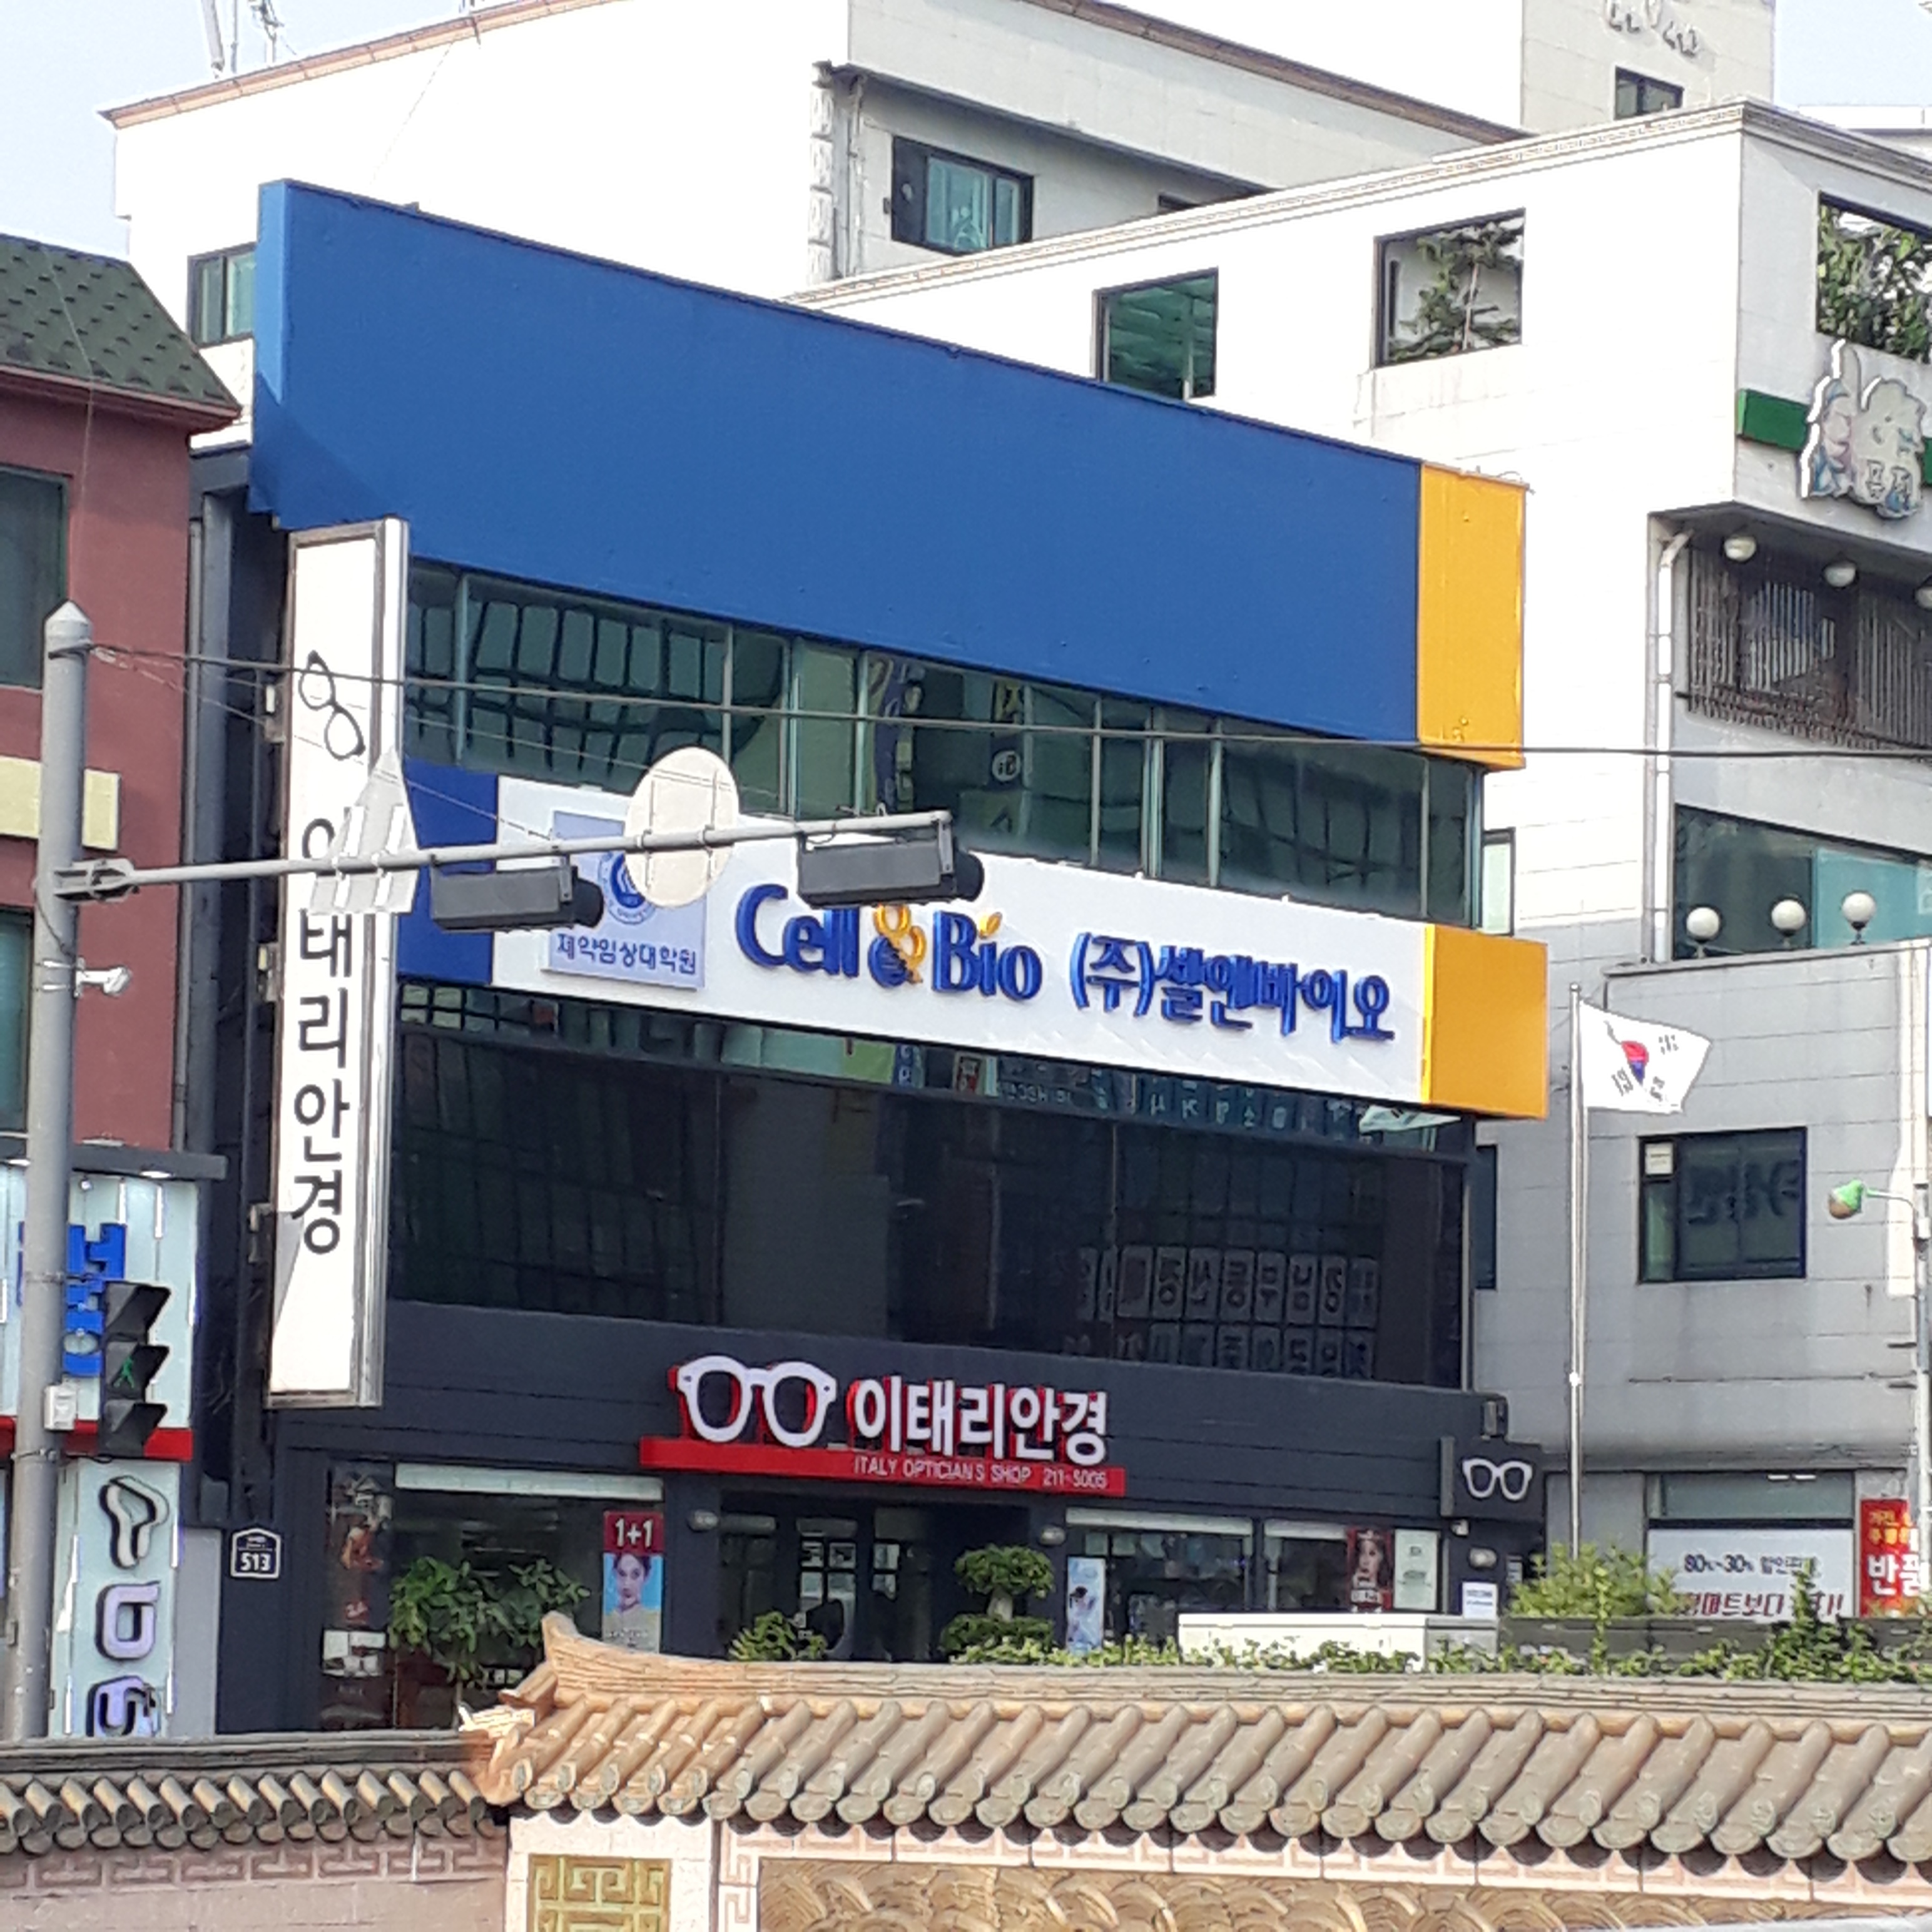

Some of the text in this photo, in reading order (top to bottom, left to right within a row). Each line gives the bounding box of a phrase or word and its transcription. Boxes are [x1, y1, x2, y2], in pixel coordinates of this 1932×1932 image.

[557, 933, 696, 975] 제약임상대학원
[735, 883, 860, 978] Cell
[932, 910, 1043, 1001] Bio
[851, 1375, 1107, 1466] 이태리안경
[854, 1456, 897, 1477] ITALY
[990, 1465, 1032, 1485] SHOP
[615, 1518, 653, 1548] 1+1
[240, 1552, 271, 1571] 513
